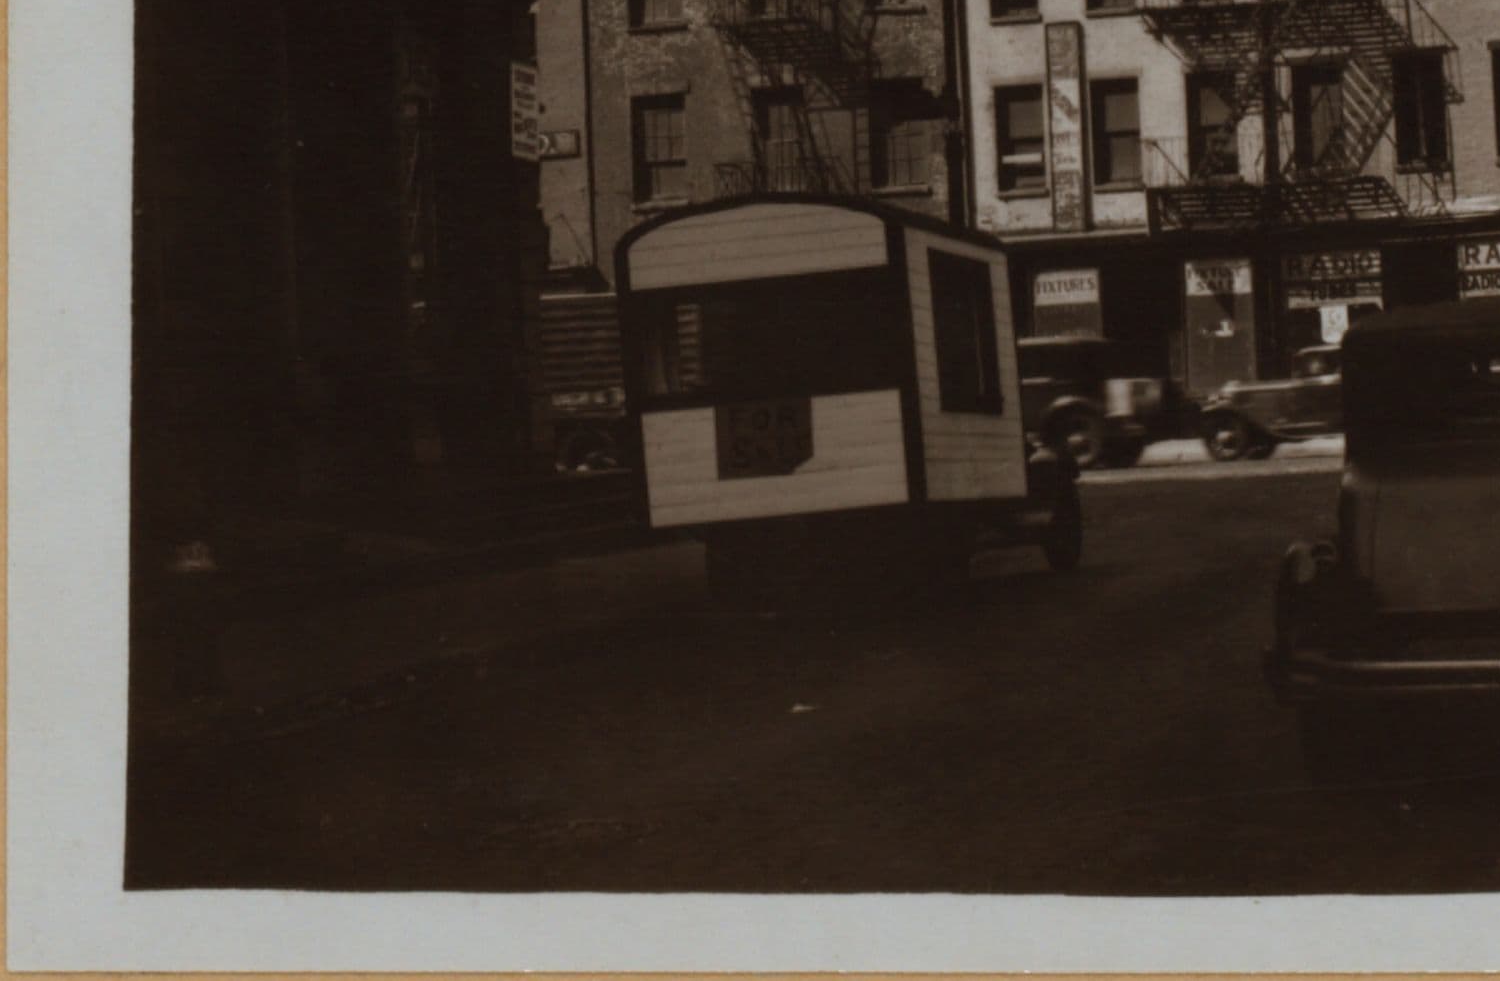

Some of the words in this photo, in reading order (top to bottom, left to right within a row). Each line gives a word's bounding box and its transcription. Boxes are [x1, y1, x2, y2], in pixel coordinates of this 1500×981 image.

[1287, 253, 1374, 279] RADIO
[1036, 279, 1097, 295] FIXTURES
[728, 406, 798, 433] FOR
